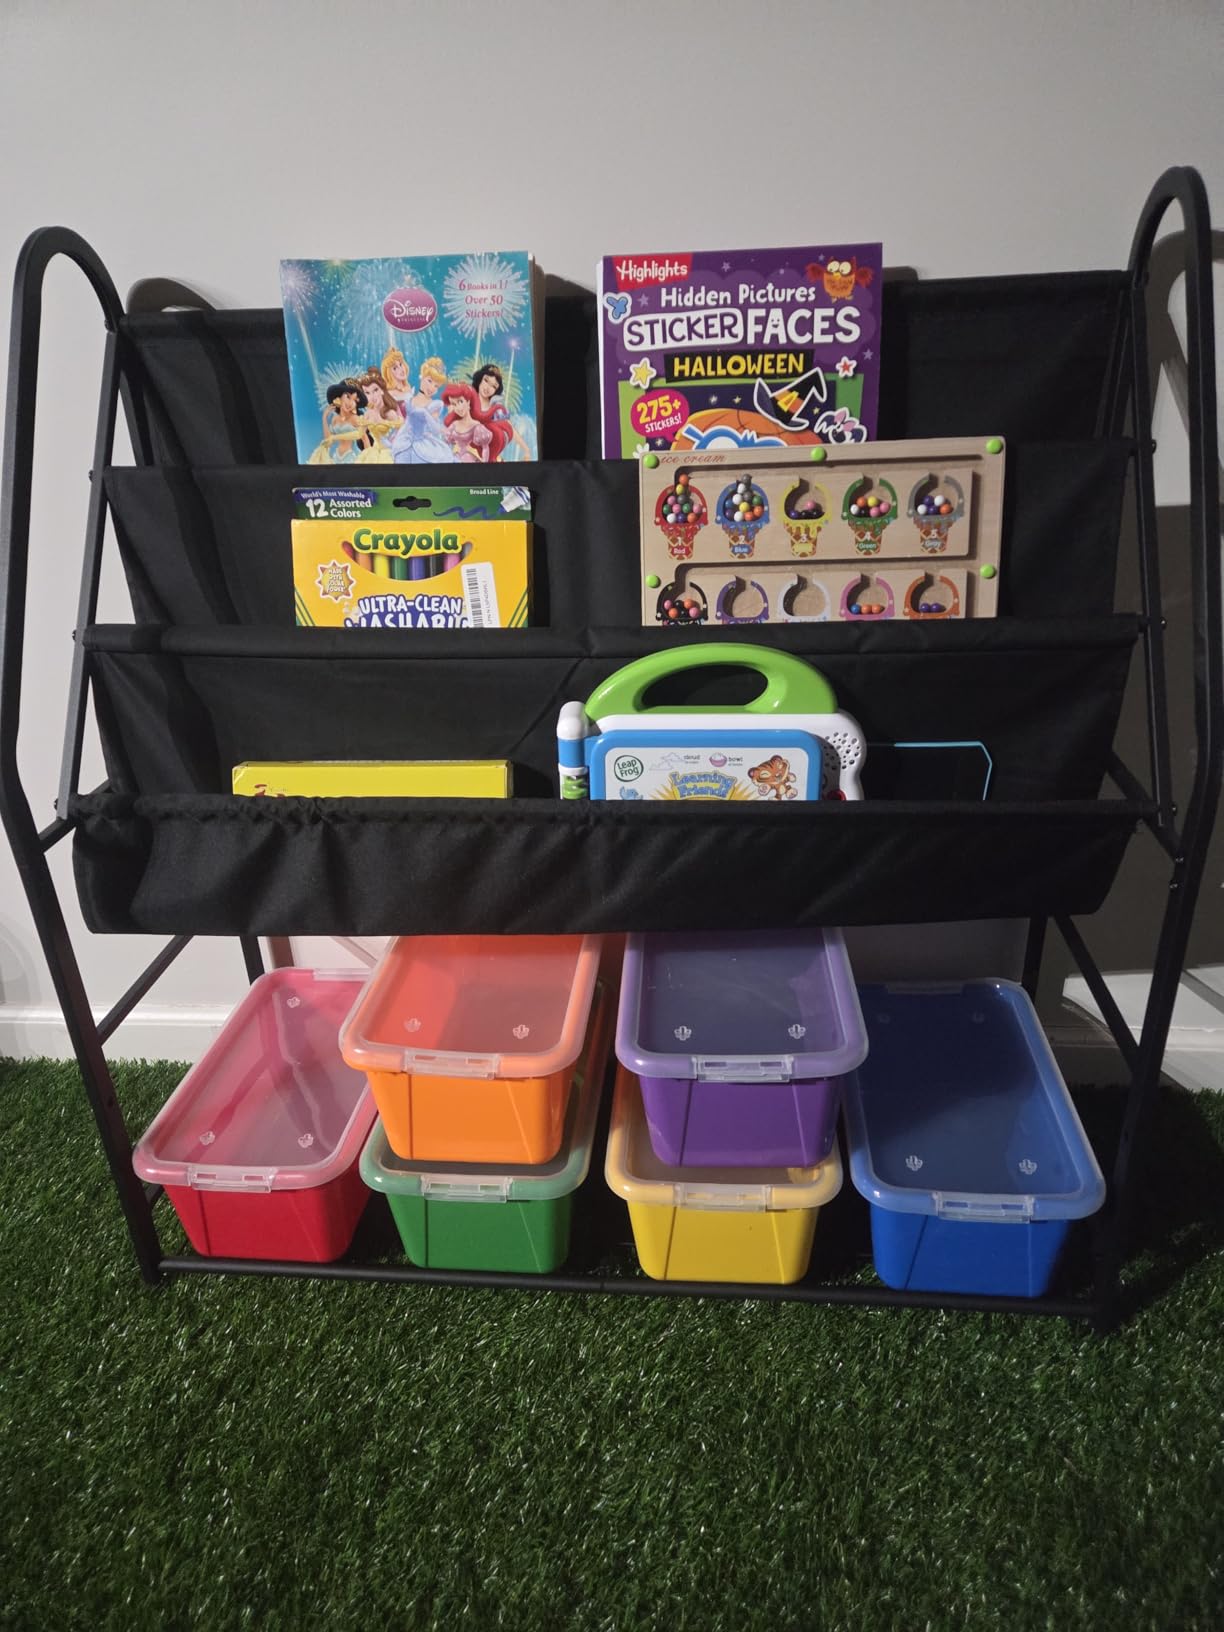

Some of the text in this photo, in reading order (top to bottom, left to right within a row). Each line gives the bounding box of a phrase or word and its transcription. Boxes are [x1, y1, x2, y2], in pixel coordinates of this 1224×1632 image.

[616, 259, 688, 282] Highlights
[458, 280, 466, 291] 6
[467, 282, 488, 290] Books
[661, 282, 816, 307] Hidden Pictures
[464, 295, 504, 305] Over 50
[464, 309, 504, 318] Stickers!
[626, 306, 861, 346] STICKER FACES
[673, 353, 805, 377] HALLOWEEN
[637, 395, 681, 424] 275+
[645, 413, 682, 433] STICKERS!
[661, 453, 727, 464] ice cream
[300, 491, 323, 499] World's
[337, 491, 365, 499] Washable
[306, 498, 373, 518] 12 Assorted
[330, 508, 362, 518] Colors
[354, 528, 459, 556] Crayola
[359, 595, 462, 615] ULTRA-CLEAN
[617, 759, 637, 770] Leap
[620, 766, 640, 778] Frog
[670, 772, 735, 788] Learning
